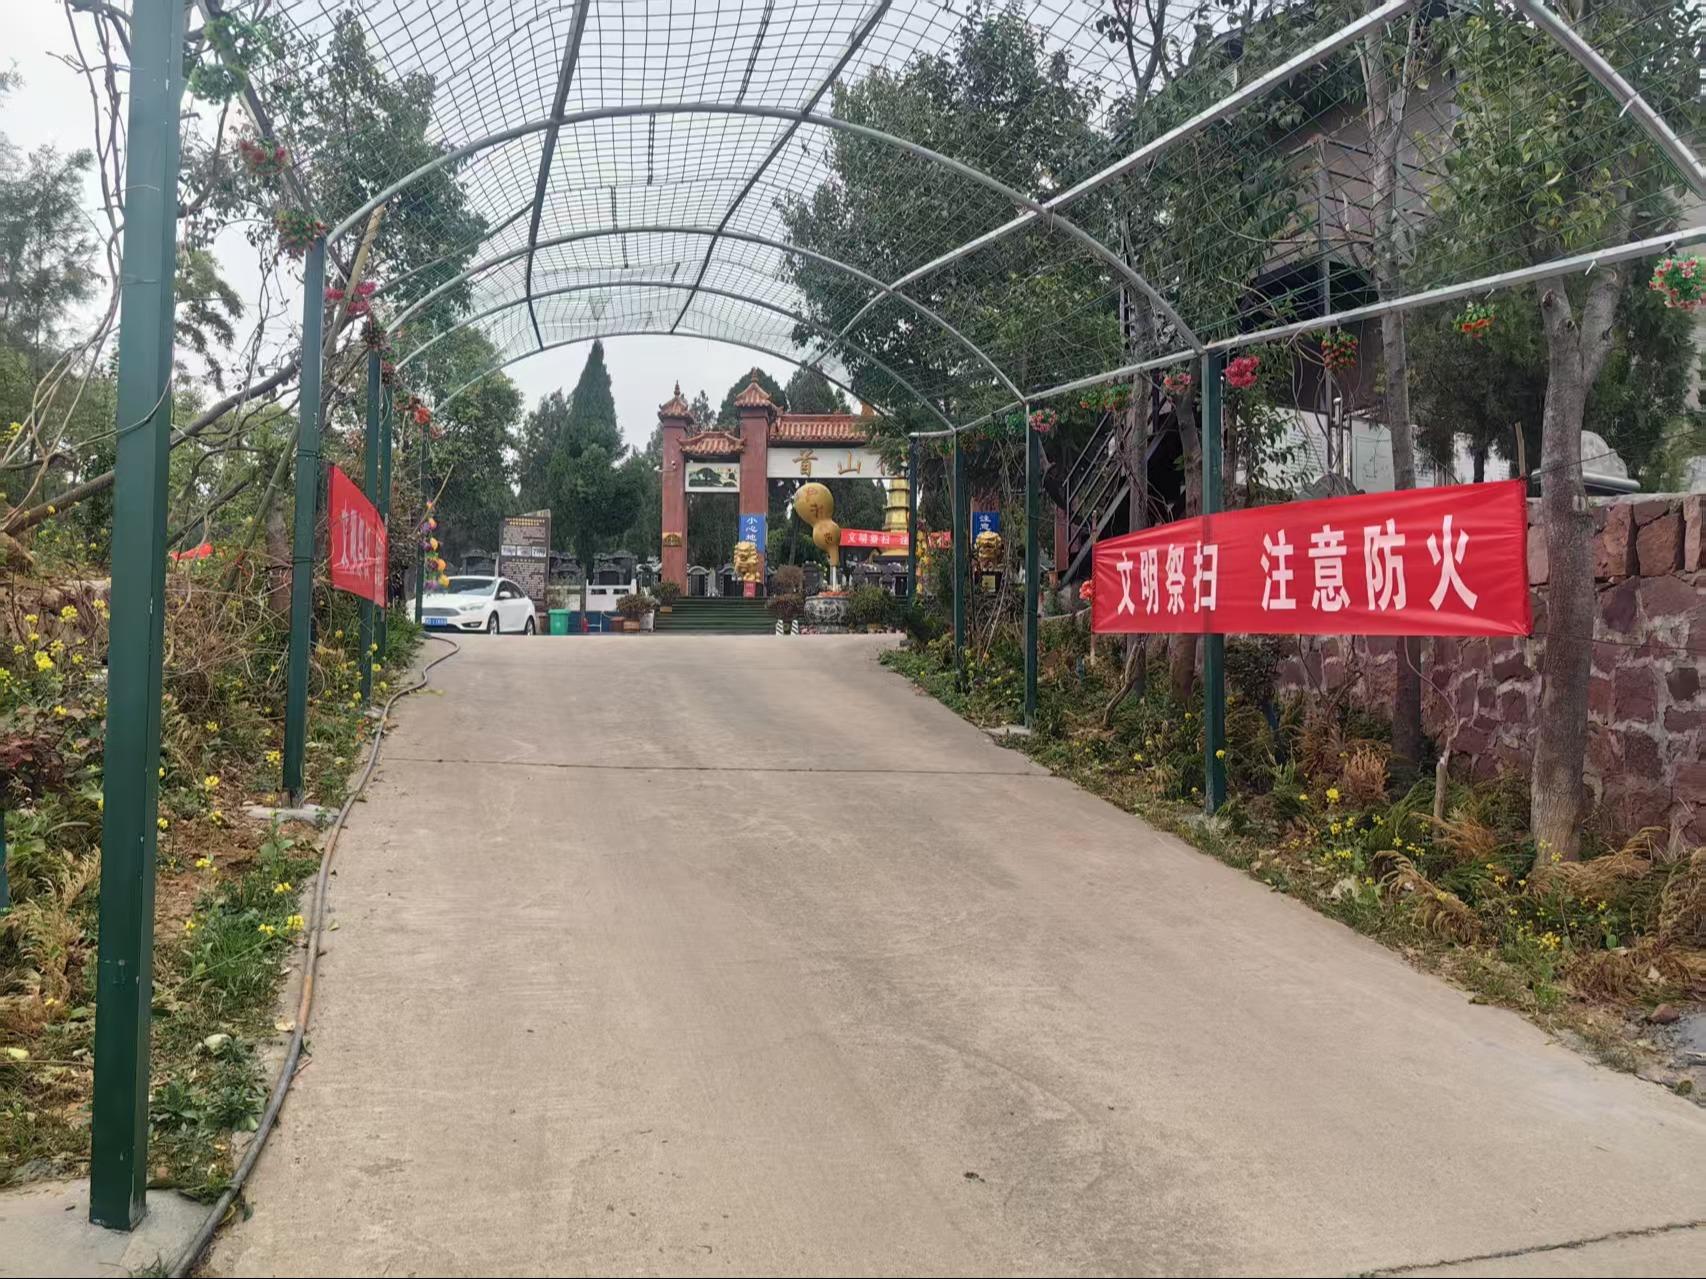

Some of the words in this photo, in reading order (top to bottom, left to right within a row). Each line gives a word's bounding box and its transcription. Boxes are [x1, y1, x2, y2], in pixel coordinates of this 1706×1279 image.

[792, 449, 890, 477] 首山
[745, 516, 759, 546] 小心地
[1116, 540, 1219, 616] 文明祭扫
[1260, 514, 1479, 612] 注意防火
